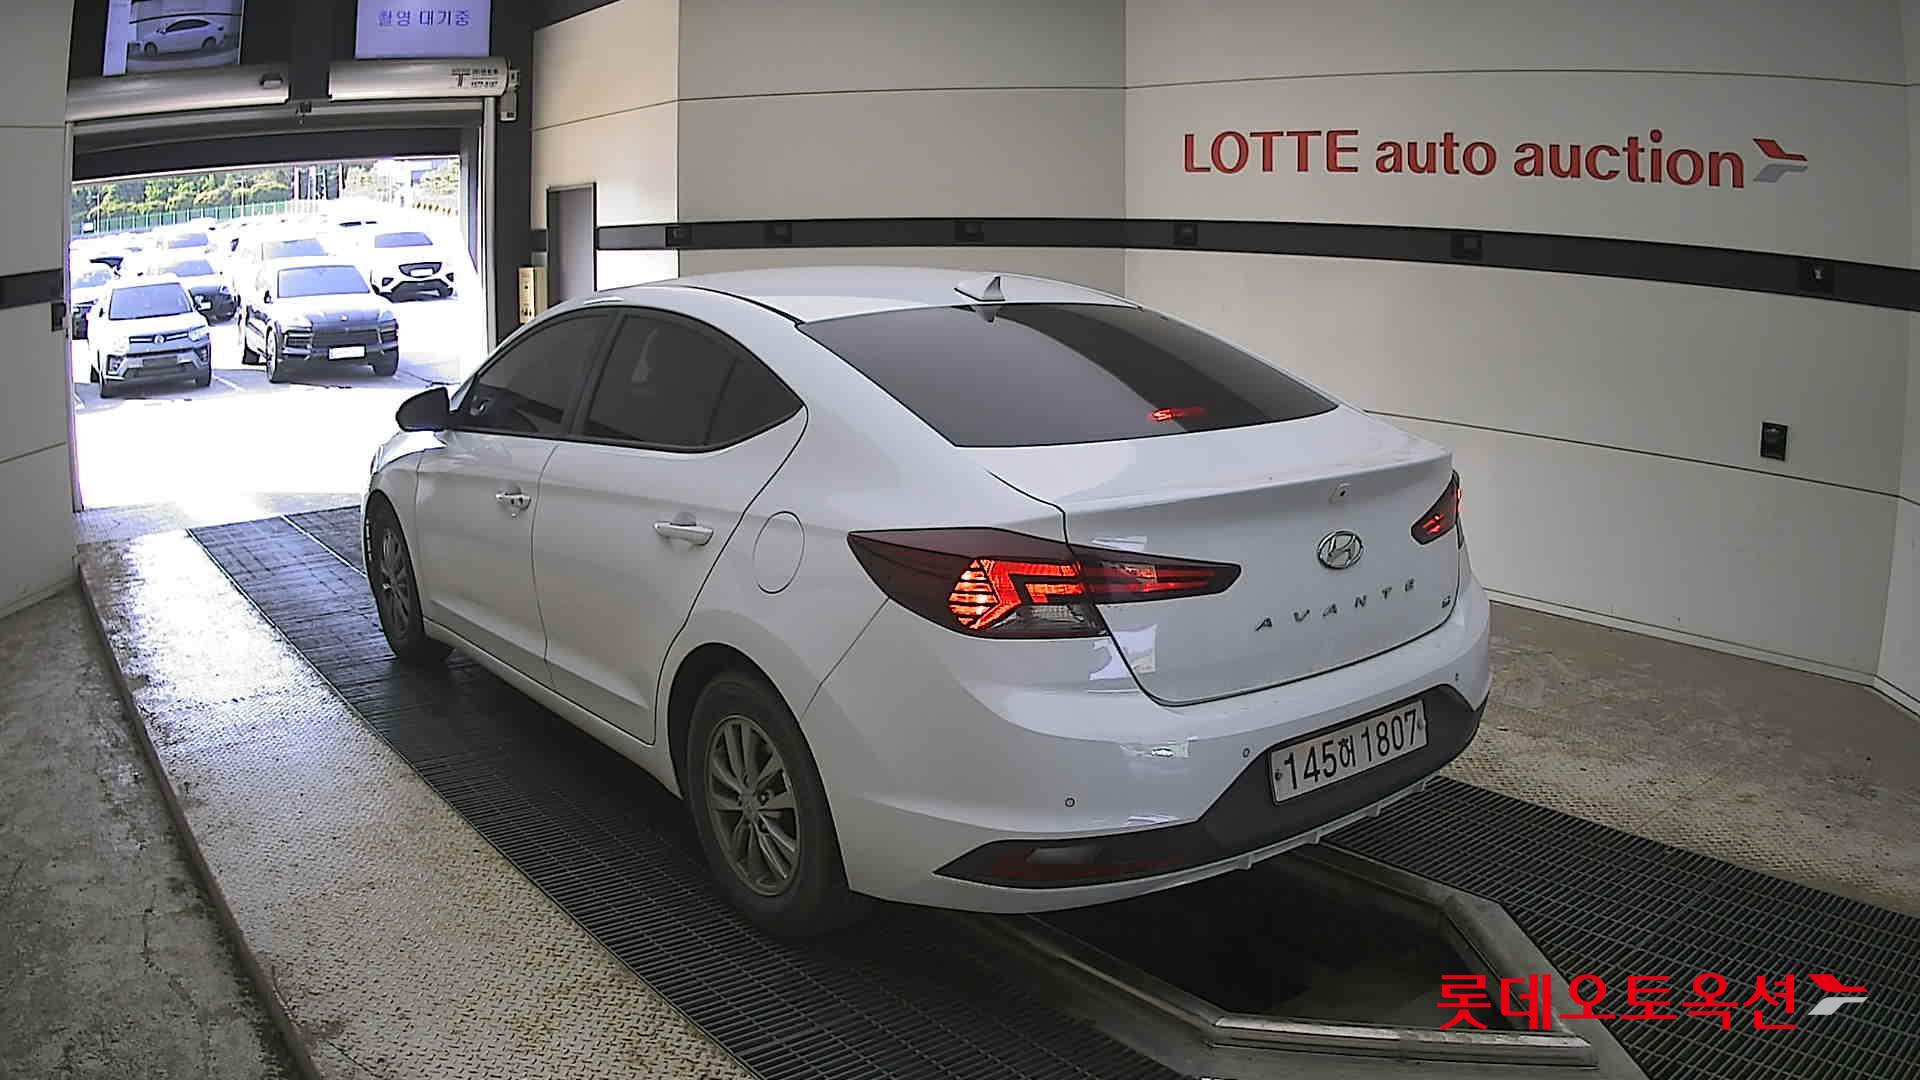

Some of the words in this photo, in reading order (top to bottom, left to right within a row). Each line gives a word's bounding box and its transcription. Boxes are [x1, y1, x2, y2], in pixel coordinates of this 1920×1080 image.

[419, 9, 470, 27] 대기중
[1183, 130, 1359, 174] LOTTE
[1375, 132, 1498, 176] auto
[1513, 130, 1744, 188] auction
[1255, 578, 1416, 632] AVANTE
